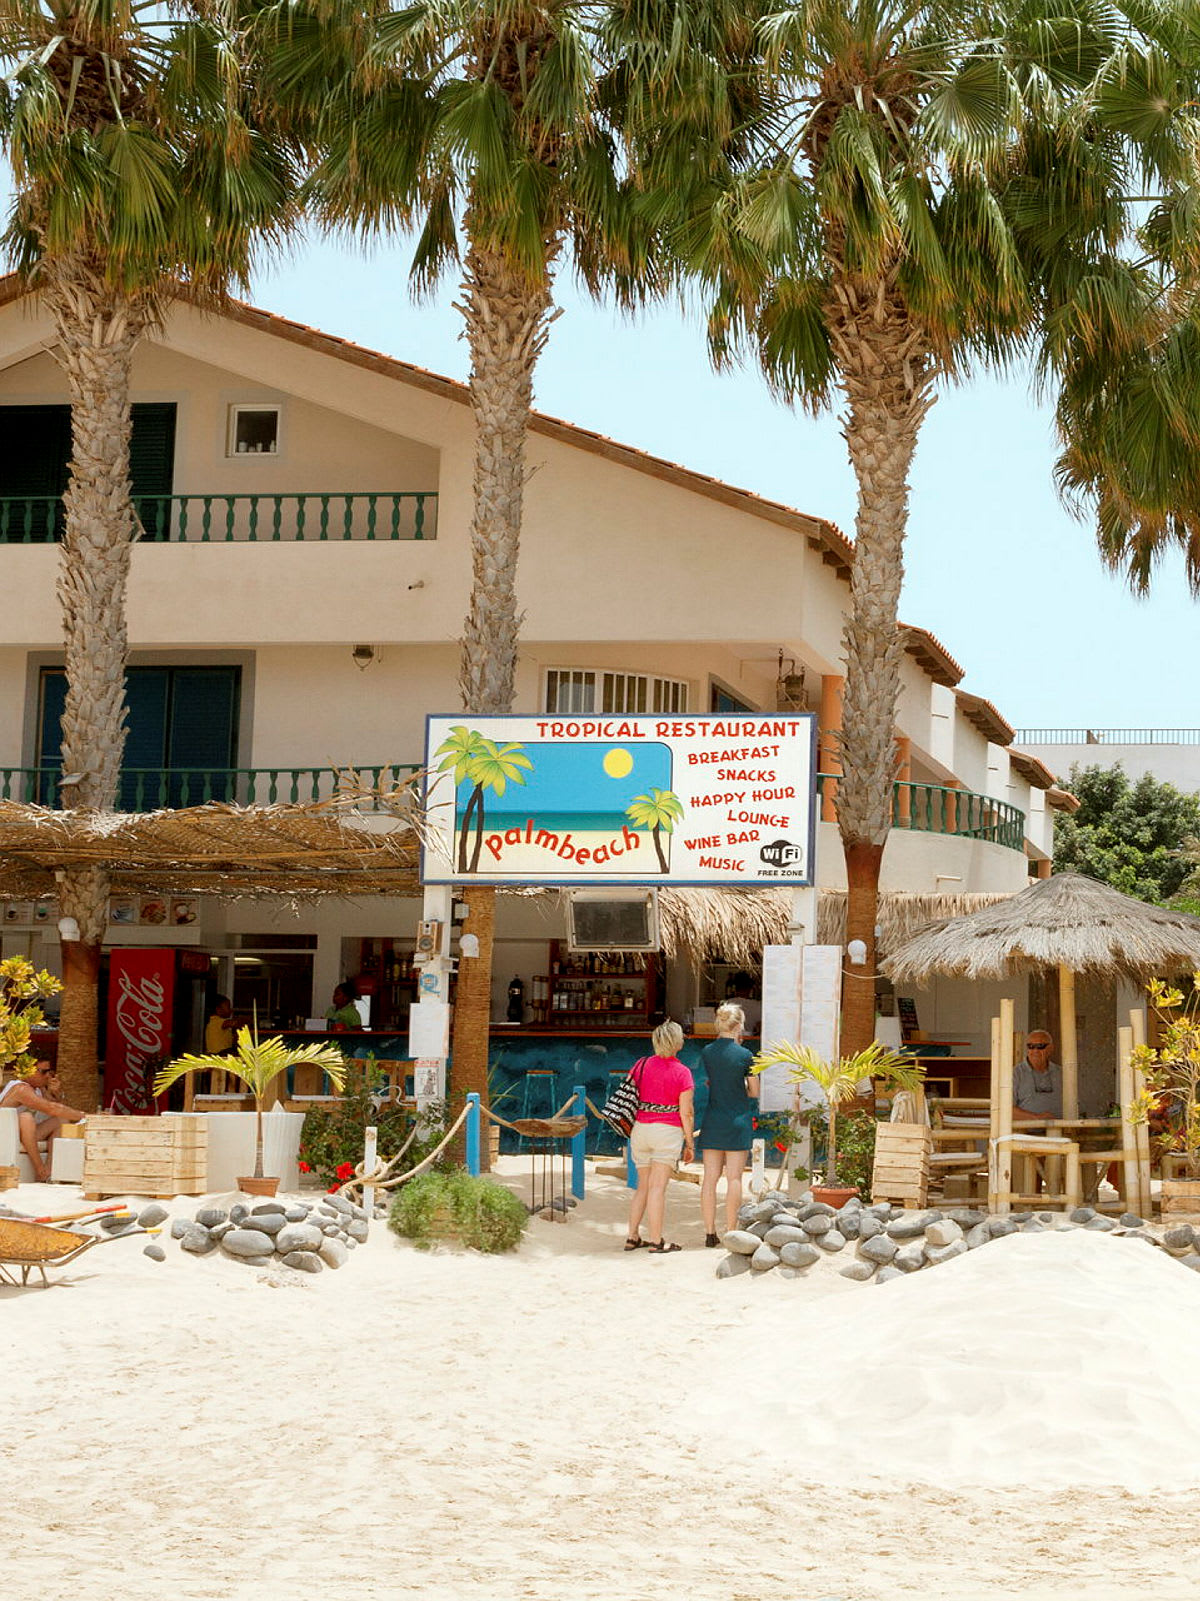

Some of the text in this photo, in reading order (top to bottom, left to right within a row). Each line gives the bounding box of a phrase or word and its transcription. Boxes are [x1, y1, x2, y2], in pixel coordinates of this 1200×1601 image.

[536, 721, 801, 738] TROPICAL RESTAURANT
[687, 745, 780, 765] BREAKFAST
[716, 769, 777, 782] SNACKS
[690, 786, 796, 808] HAPPY HOUR
[727, 809, 790, 828] LOUNGE
[484, 819, 641, 865] palmbeach
[683, 829, 761, 851] WINE BAR
[698, 856, 745, 872] MUSIC
[757, 869, 804, 877] FREE ZONE
